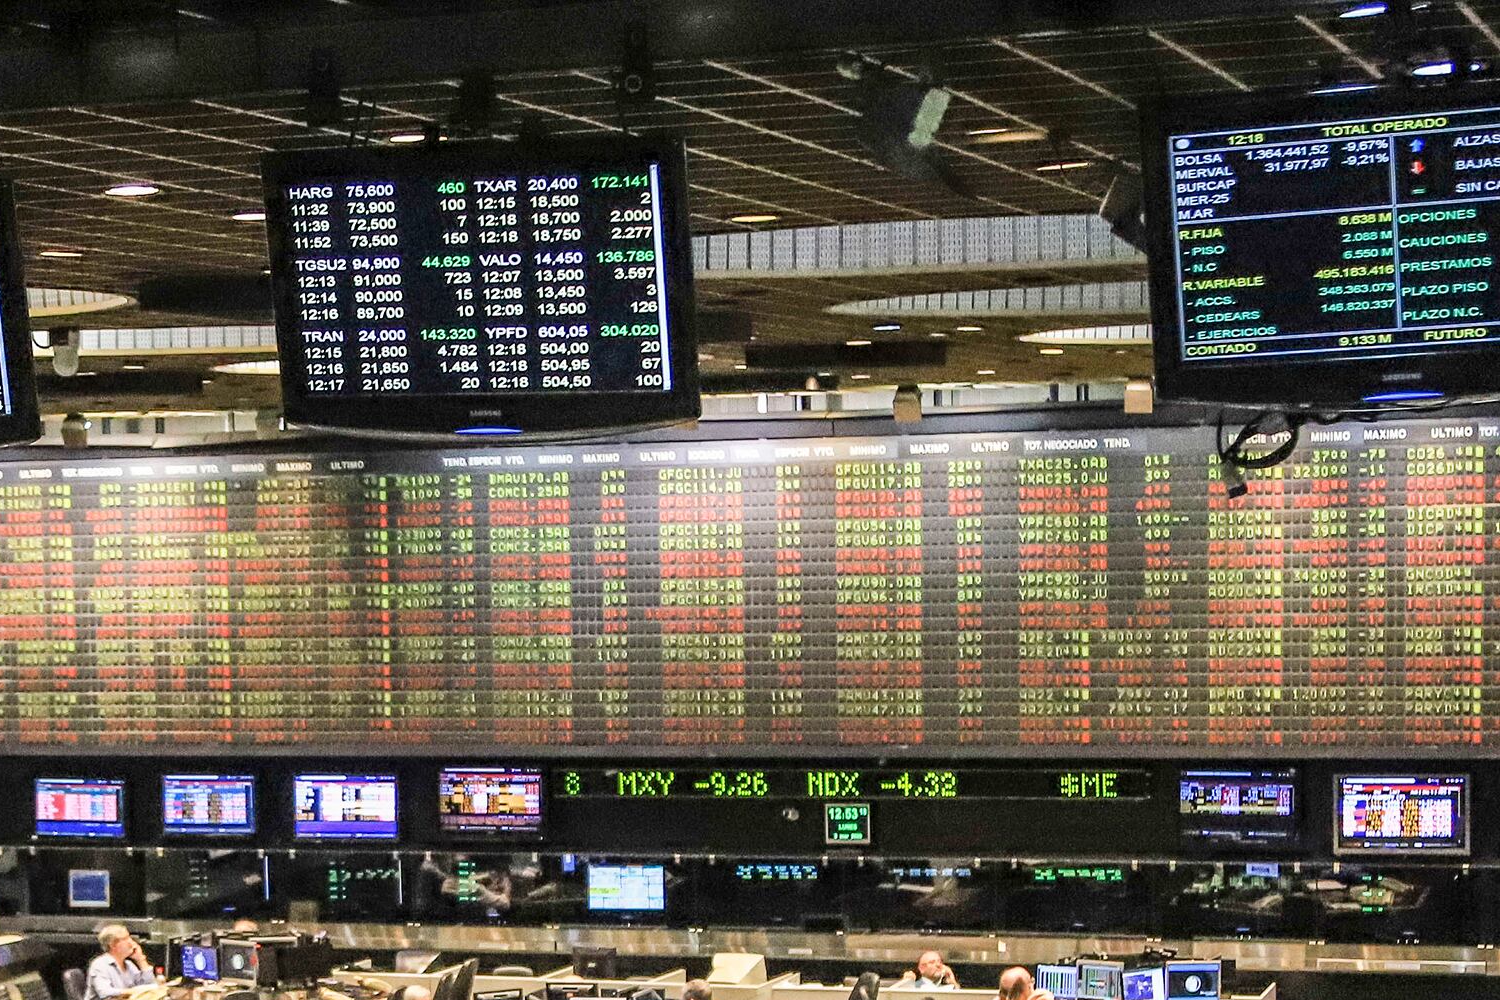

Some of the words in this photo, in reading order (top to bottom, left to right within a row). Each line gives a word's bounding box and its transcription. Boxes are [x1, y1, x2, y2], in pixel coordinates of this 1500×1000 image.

[1229, 134, 1263, 145] 12:18
[1323, 124, 1370, 136] TOTAL
[1373, 118, 1447, 134] OPERADO
[1175, 154, 1222, 166] BOLSA
[1175, 166, 1233, 180] MERVAL
[290, 187, 333, 199] HARG
[346, 184, 393, 198] 75,600
[438, 182, 465, 193] 460
[474, 180, 517, 192] TXAR
[528, 177, 578, 191] 20,400
[592, 175, 649, 189] 172.141
[1176, 179, 1236, 193] BURCAP
[1457, 181, 1483, 192] SIN
[1177, 194, 1230, 206] MER-25
[1178, 208, 1213, 219] M.AR
[1378, 213, 1392, 222] M
[1399, 209, 1477, 223] OPCIONES
[1179, 228, 1222, 240] R.FIJA
[1379, 231, 1393, 240] M
[1399, 233, 1487, 248] CAUCIONES
[1192, 245, 1225, 255] PISO
[1380, 247, 1394, 257] M
[296, 259, 346, 271] TGSU2
[353, 257, 400, 270] 94,900
[422, 256, 470, 267] 44.629
[479, 254, 521, 266] VALO
[535, 251, 583, 265] 14,450
[597, 250, 654, 263] 136.786
[1400, 257, 1492, 272] PRESTAMOS
[1182, 276, 1264, 291] R.VARIABLE
[1402, 285, 1450, 297] PLAZO
[1452, 281, 1488, 293] PISO
[1194, 296, 1236, 307] ACCS.
[1194, 310, 1261, 323] CEDEARS
[1402, 309, 1450, 321] PLAZO
[1454, 307, 1483, 317] N.C.
[302, 331, 343, 342] TRAN
[359, 329, 406, 342] 24,000
[421, 329, 476, 340] 143.320
[485, 327, 527, 338] YPFD
[538, 325, 588, 338] 604,05
[600, 324, 659, 337] 304.020
[1197, 326, 1276, 340] EJERCICIOS
[1186, 343, 1256, 355] CONTADO
[1339, 335, 1377, 346] 9.133
[1379, 333, 1391, 343] M
[1425, 328, 1486, 340] FUTURO
[1311, 431, 1351, 442] MINIMO
[1364, 430, 1406, 440] MAXIMO
[1431, 428, 1473, 439] ULTIMO
[850, 445, 886, 455] MINIMO
[910, 443, 949, 454] MAXIMO
[971, 442, 1009, 452] ULTIMO
[1044, 439, 1098, 450] NEGOCIADO
[1104, 438, 1130, 448] TEND.
[538, 454, 573, 464] MINIMO
[583, 453, 619, 463] MAXIMO
[640, 451, 676, 462] ULTIMO
[276, 462, 312, 472] MAXIMO
[330, 461, 364, 470] ULTIMO
[566, 771, 580, 796] 8
[617, 771, 675, 796] MXY
[807, 772, 860, 796] NDX
[1060, 773, 1117, 798] $ME
